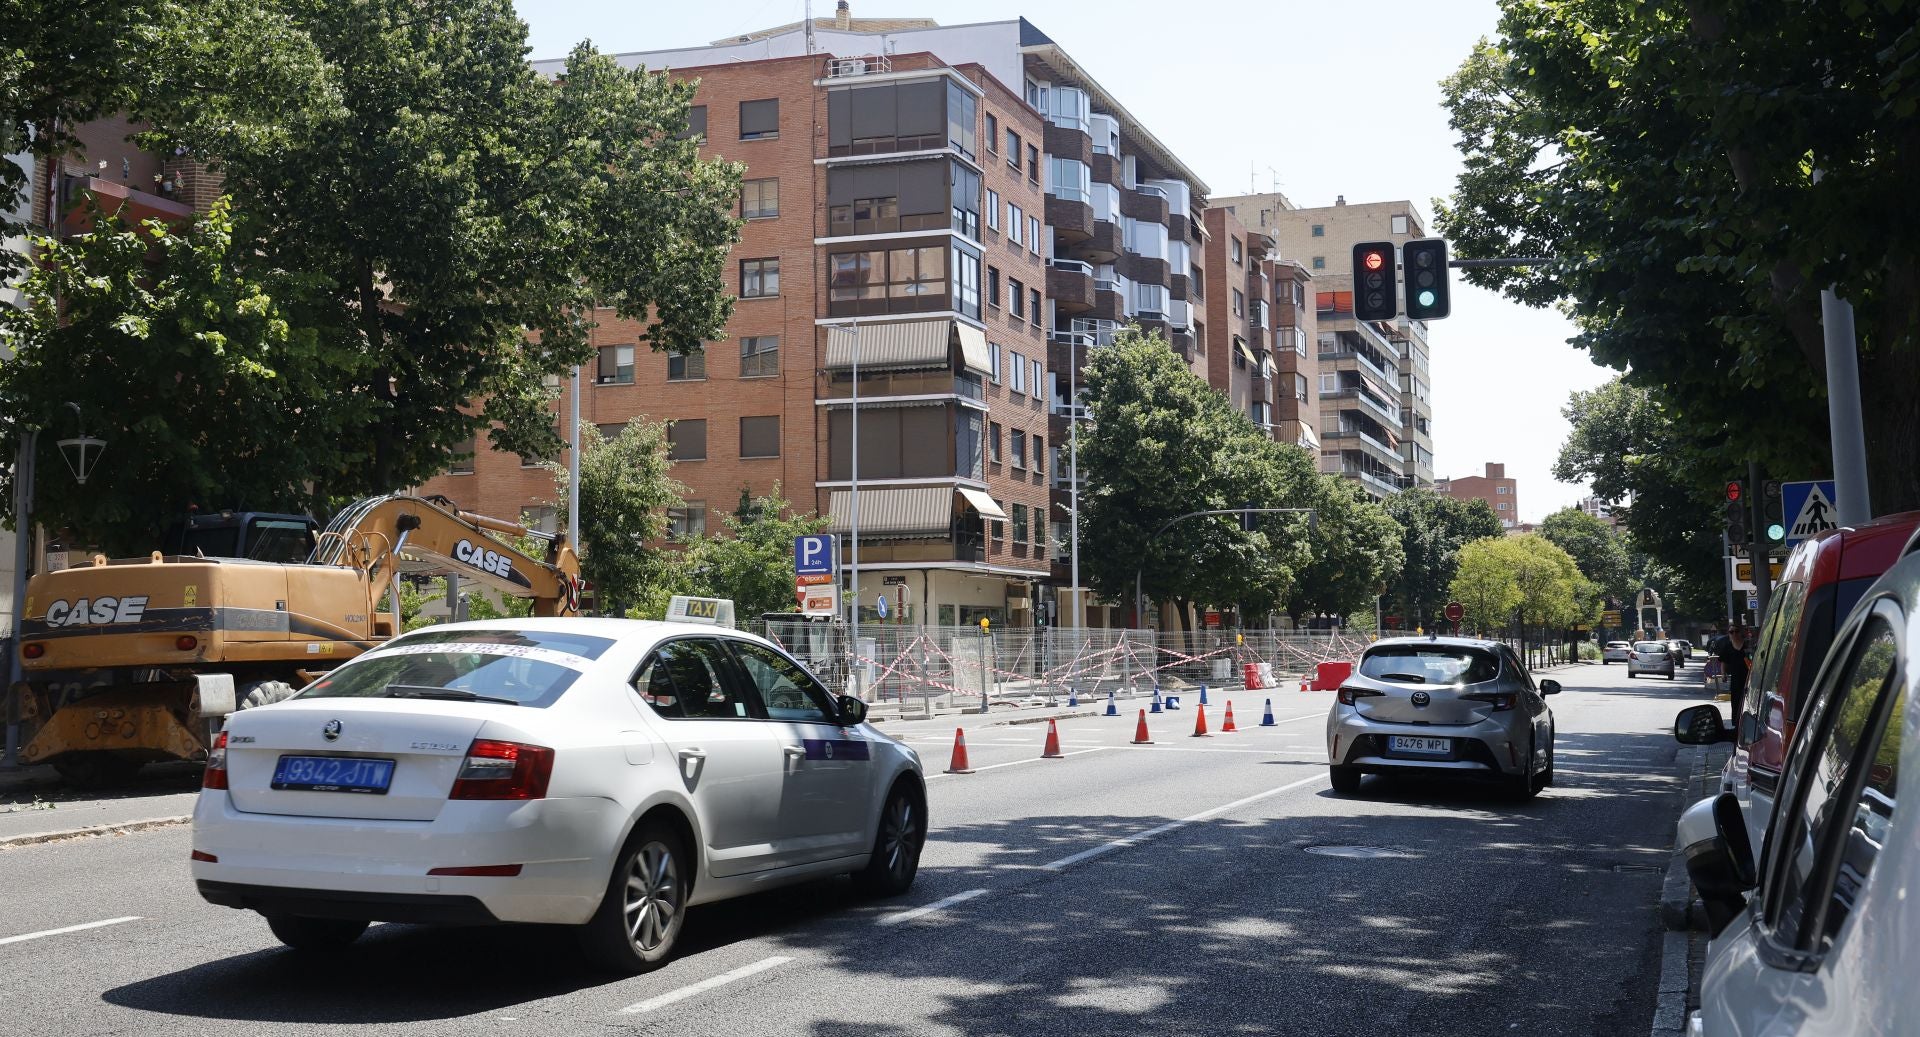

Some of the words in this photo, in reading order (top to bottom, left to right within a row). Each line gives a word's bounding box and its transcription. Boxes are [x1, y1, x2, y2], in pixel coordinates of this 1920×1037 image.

[456, 539, 513, 578] CASE
[803, 537, 823, 566] P
[46, 596, 149, 627] CASE
[688, 600, 716, 617] TAXI
[1396, 738, 1423, 749] 9476
[1427, 740, 1449, 751] MPL
[288, 760, 340, 783] 9342
[345, 763, 389, 785] JTW
